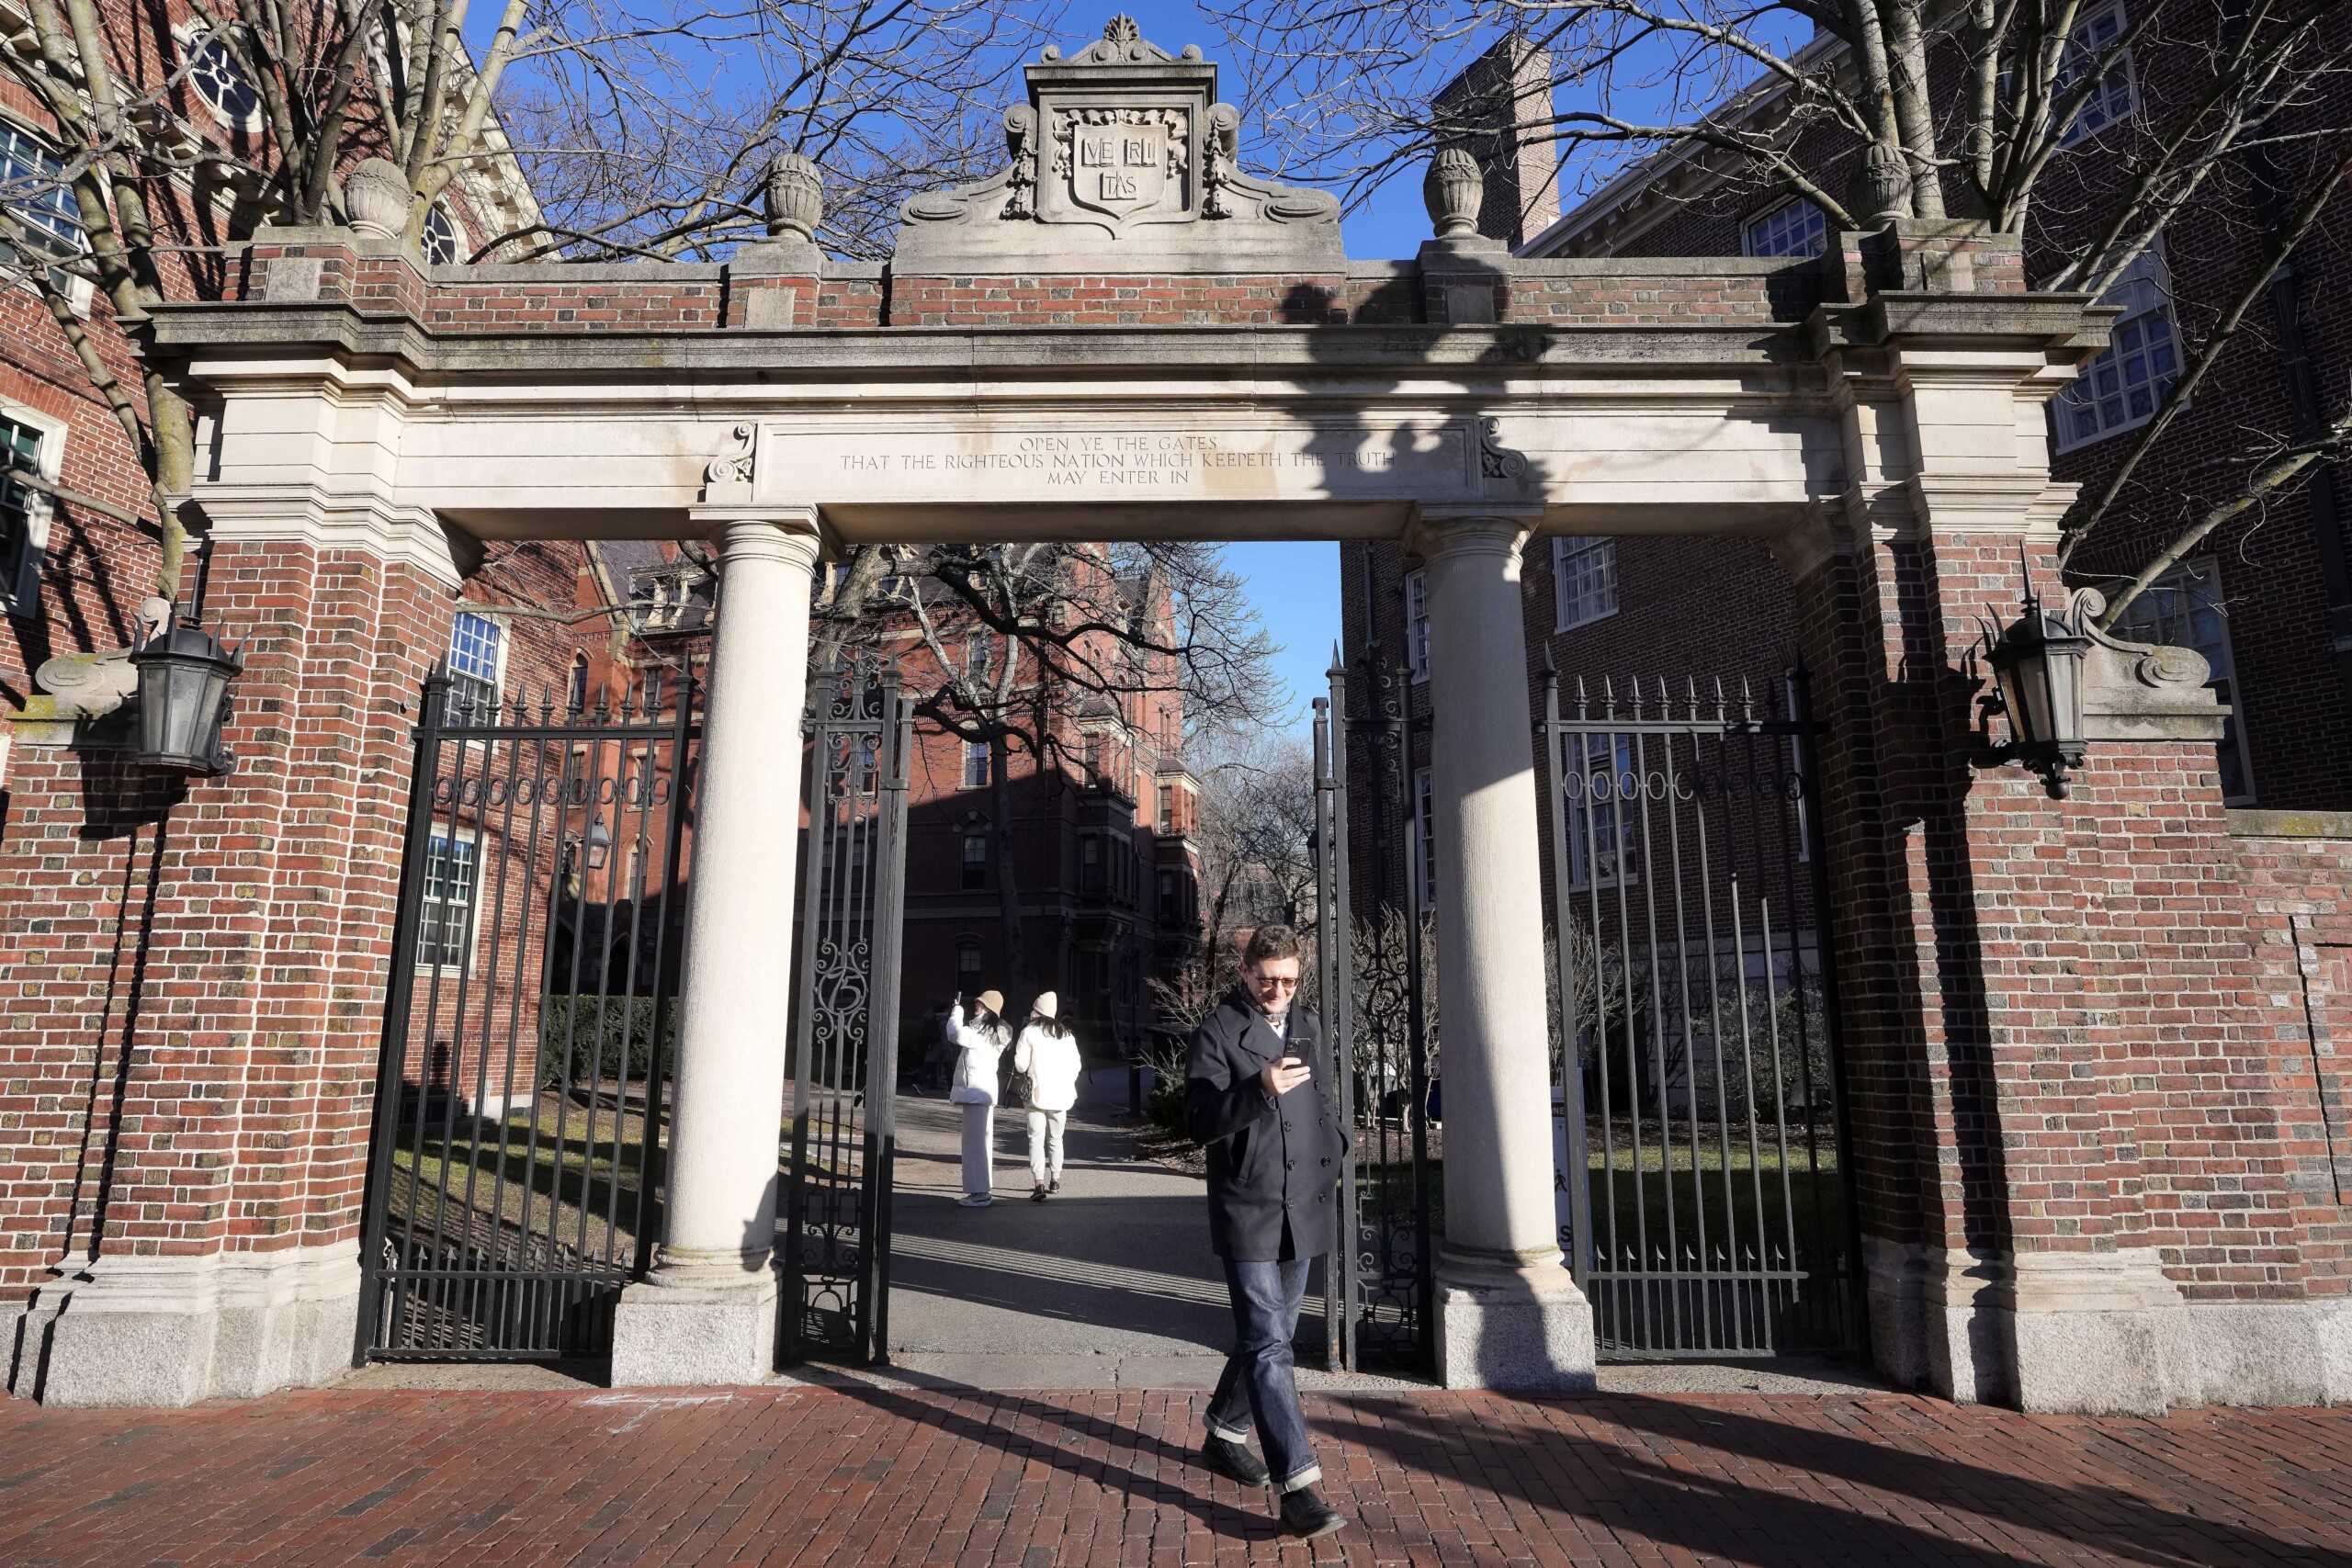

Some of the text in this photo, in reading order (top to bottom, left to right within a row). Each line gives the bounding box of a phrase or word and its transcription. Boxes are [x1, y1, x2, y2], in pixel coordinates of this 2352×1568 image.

[1105, 175, 1136, 195] TAS
[1020, 436, 1217, 451] OPEN YE THE GATES
[841, 451, 1396, 470] THAT THE RIGHTEOUS NATION WHICH KEEPETH THE TRUTH
[1047, 470, 1189, 485] MAY ENTER IN
